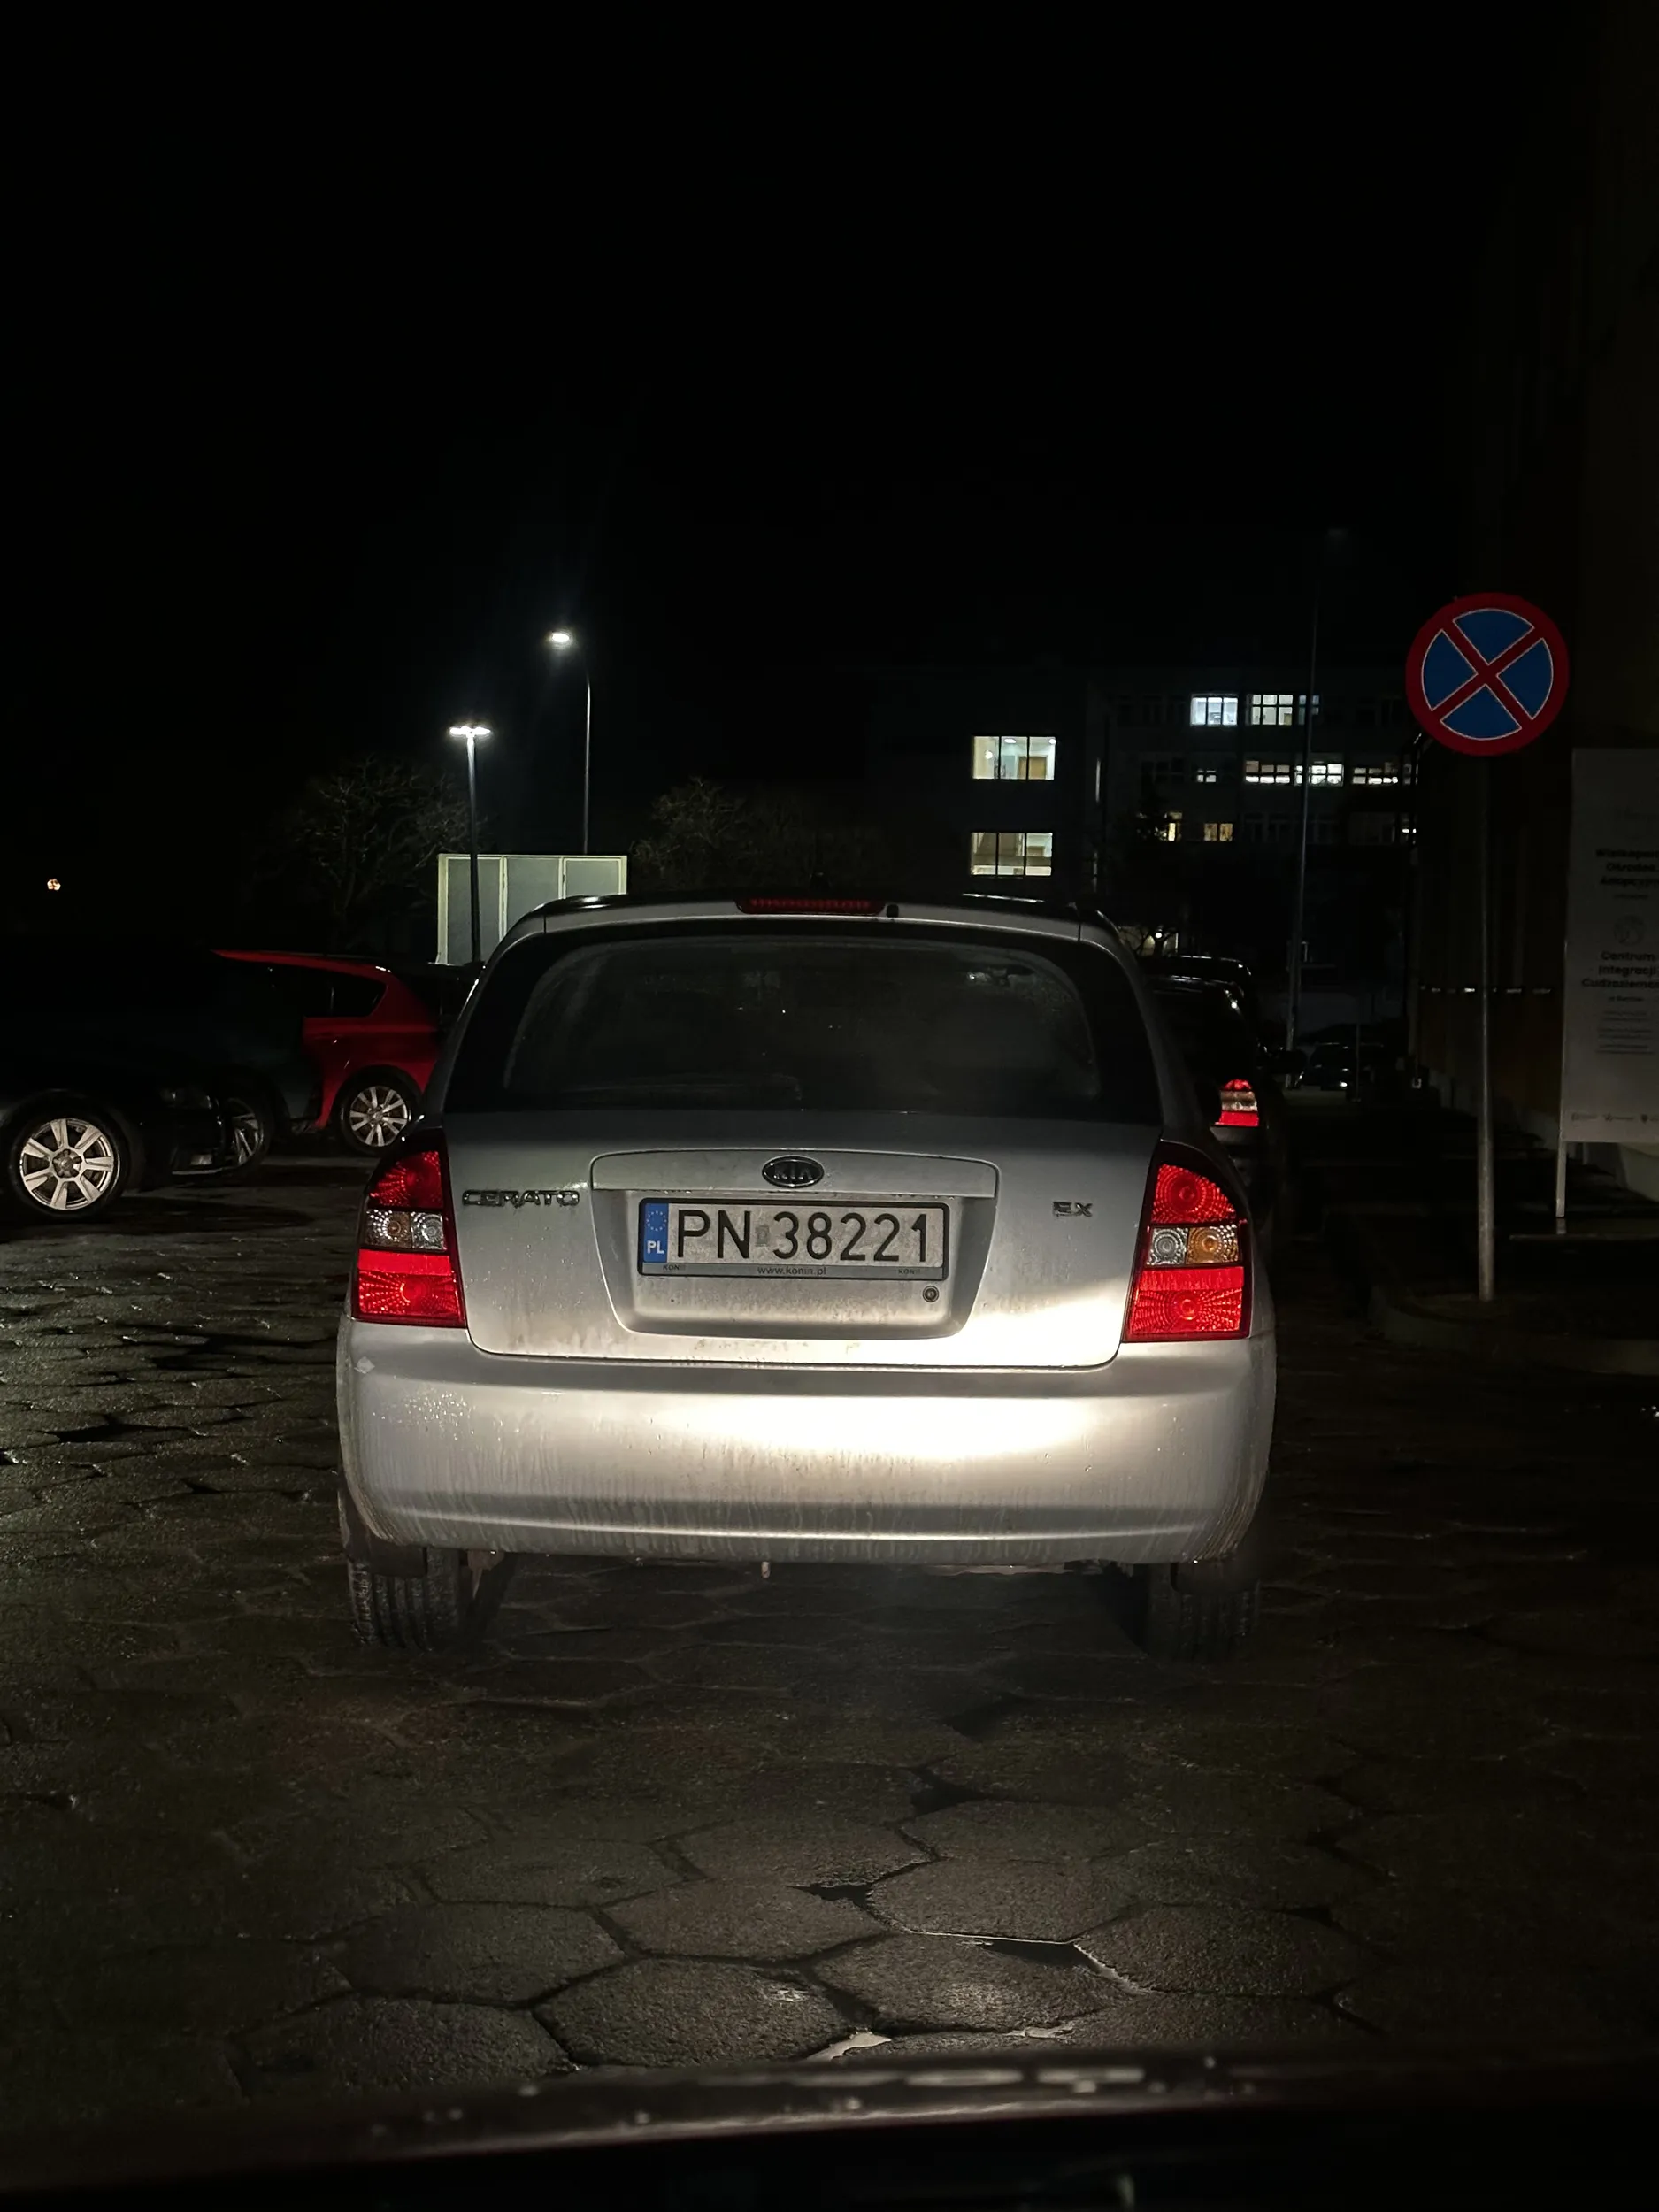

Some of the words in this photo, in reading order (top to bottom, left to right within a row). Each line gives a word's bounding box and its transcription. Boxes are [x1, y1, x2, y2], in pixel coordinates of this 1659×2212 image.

[1601, 950, 1656, 961] Centrum
[1599, 964, 1656, 978] Integracji
[462, 1189, 580, 1208] CERATO
[1052, 1202, 1093, 1217] EX
[678, 1210, 751, 1258] PN
[772, 1210, 927, 1263] 38221
[647, 1240, 665, 1254] PL
